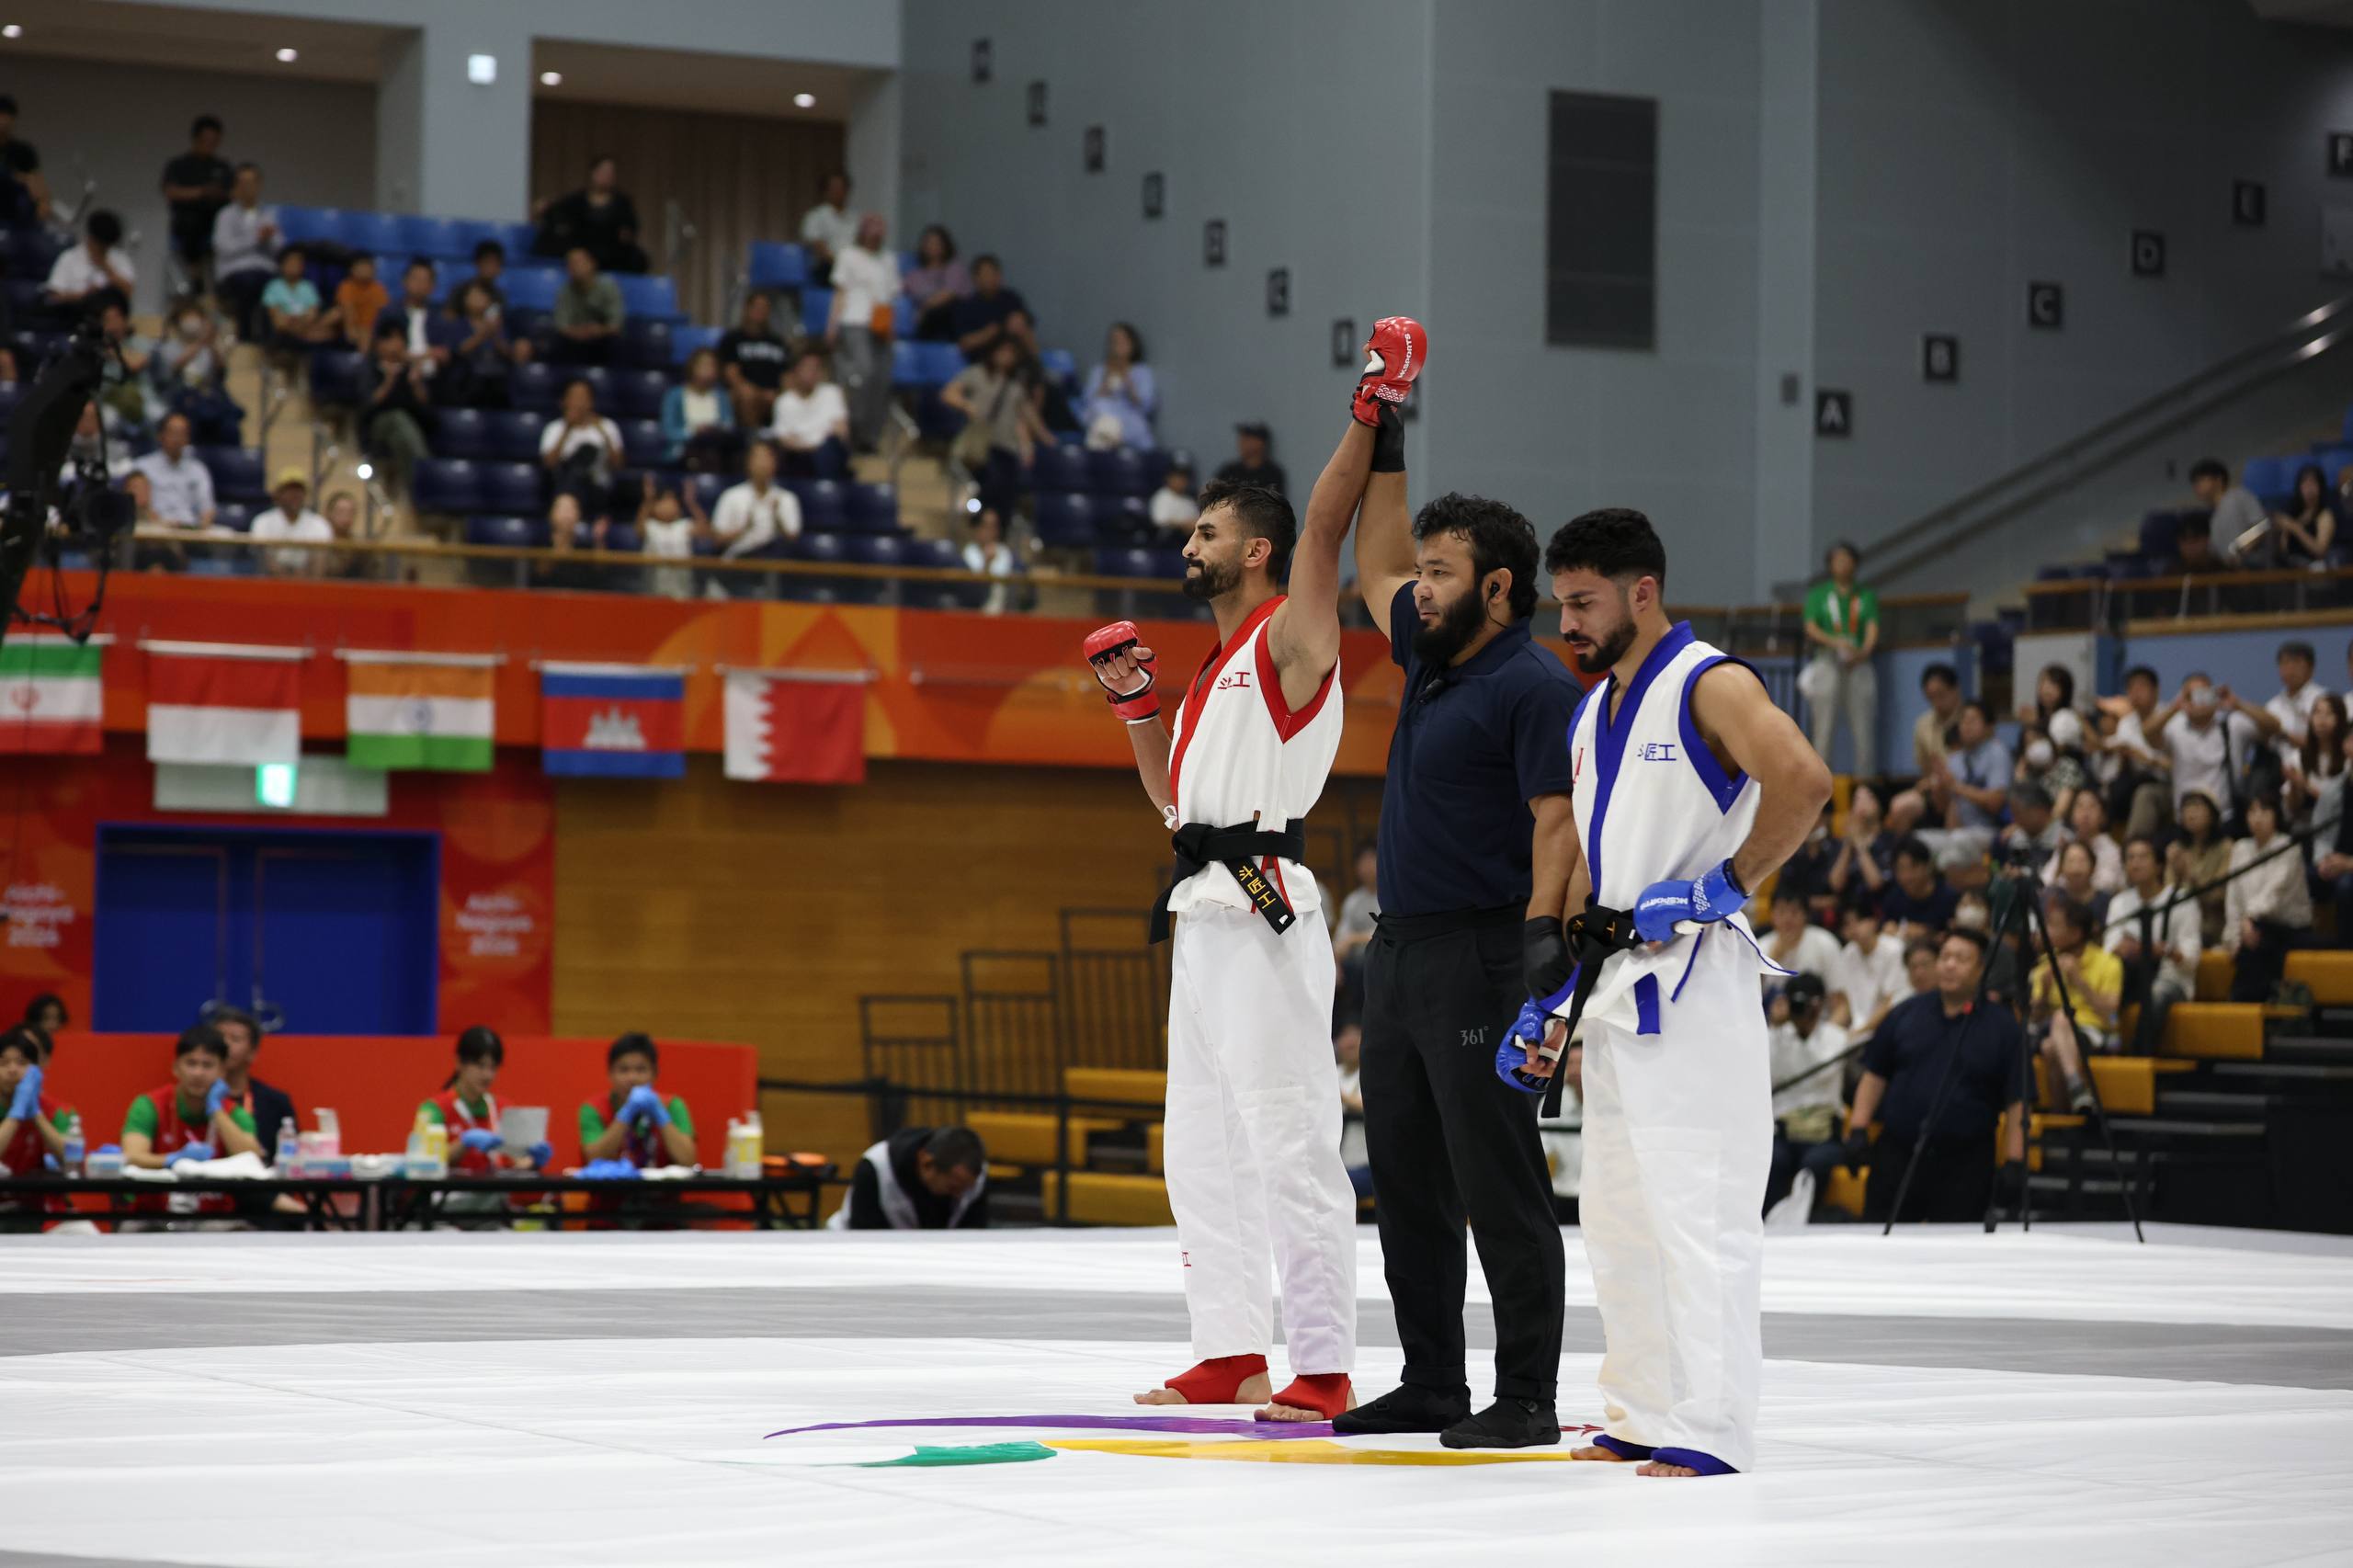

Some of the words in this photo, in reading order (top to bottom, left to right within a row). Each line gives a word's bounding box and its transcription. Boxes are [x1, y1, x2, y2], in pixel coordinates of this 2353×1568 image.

[2034, 290, 2054, 322] C
[1821, 397, 1844, 428] A
[1238, 865, 1277, 909] 斗匠工
